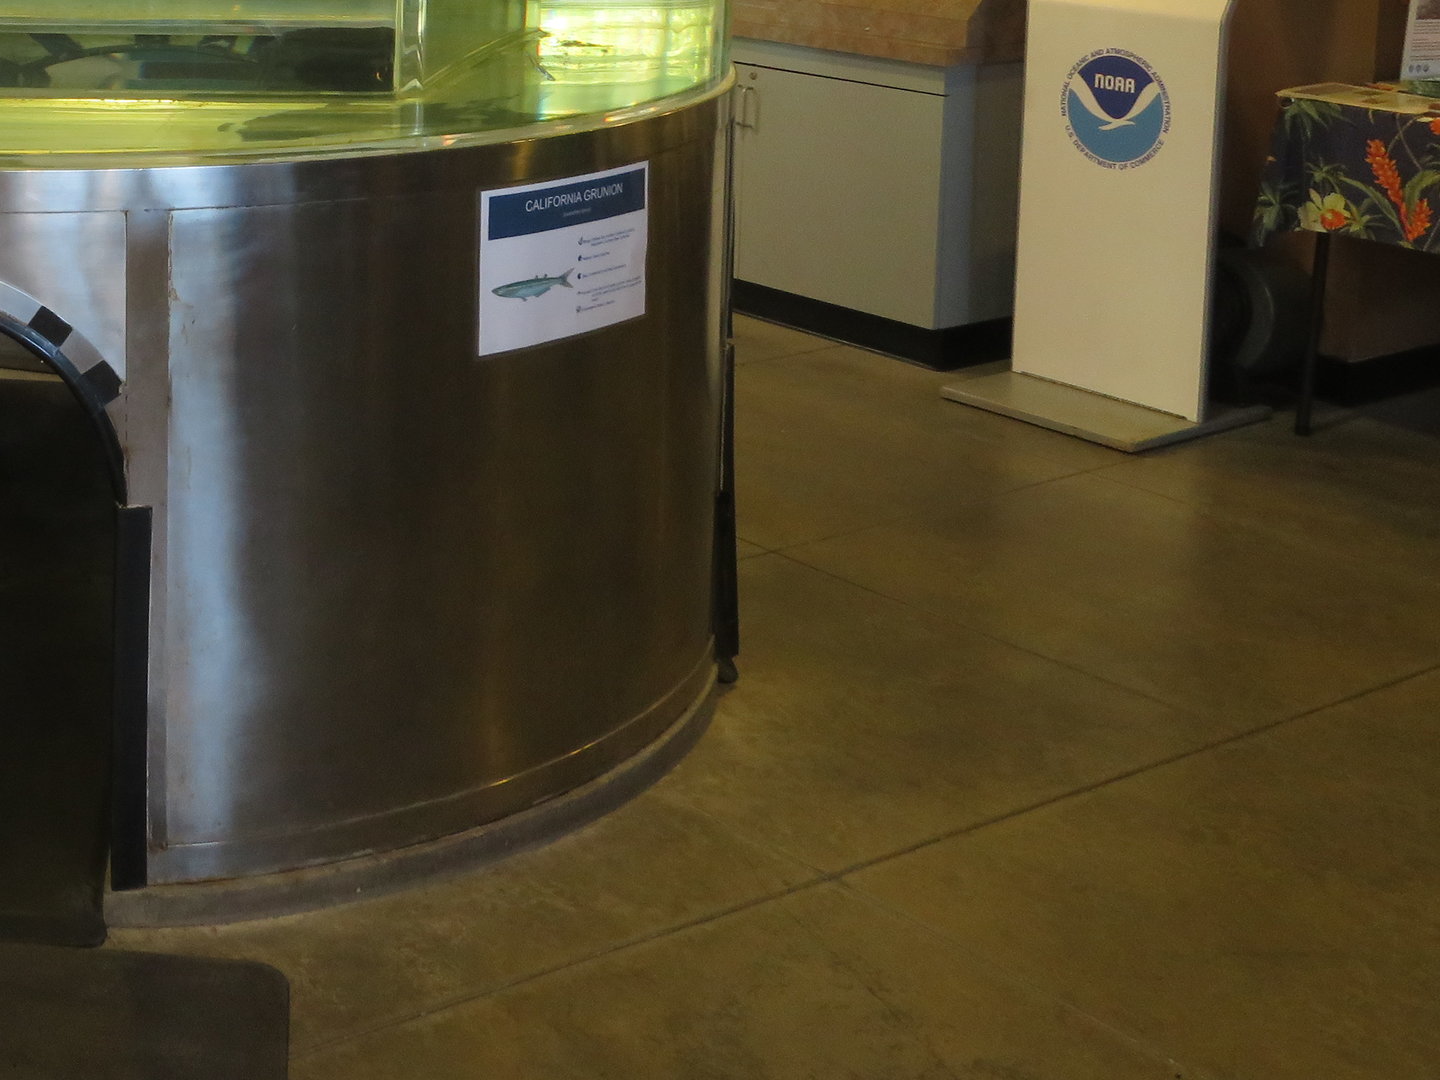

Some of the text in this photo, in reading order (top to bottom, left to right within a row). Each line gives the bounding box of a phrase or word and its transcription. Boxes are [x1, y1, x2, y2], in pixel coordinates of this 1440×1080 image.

[1061, 81, 1070, 117] NATIONAL
[1068, 55, 1090, 80] OCEANIC
[1090, 48, 1105, 59] AND
[1105, 47, 1153, 73] ATMOSPHERIC
[1094, 73, 1136, 93] NOAA
[1072, 139, 1117, 170] DEPARTMENT
[1118, 163, 1129, 171] OF
[1130, 139, 1165, 170] COMMERCE
[525, 191, 583, 213] CALIFORNIA
[583, 182, 624, 202] GRUNION
